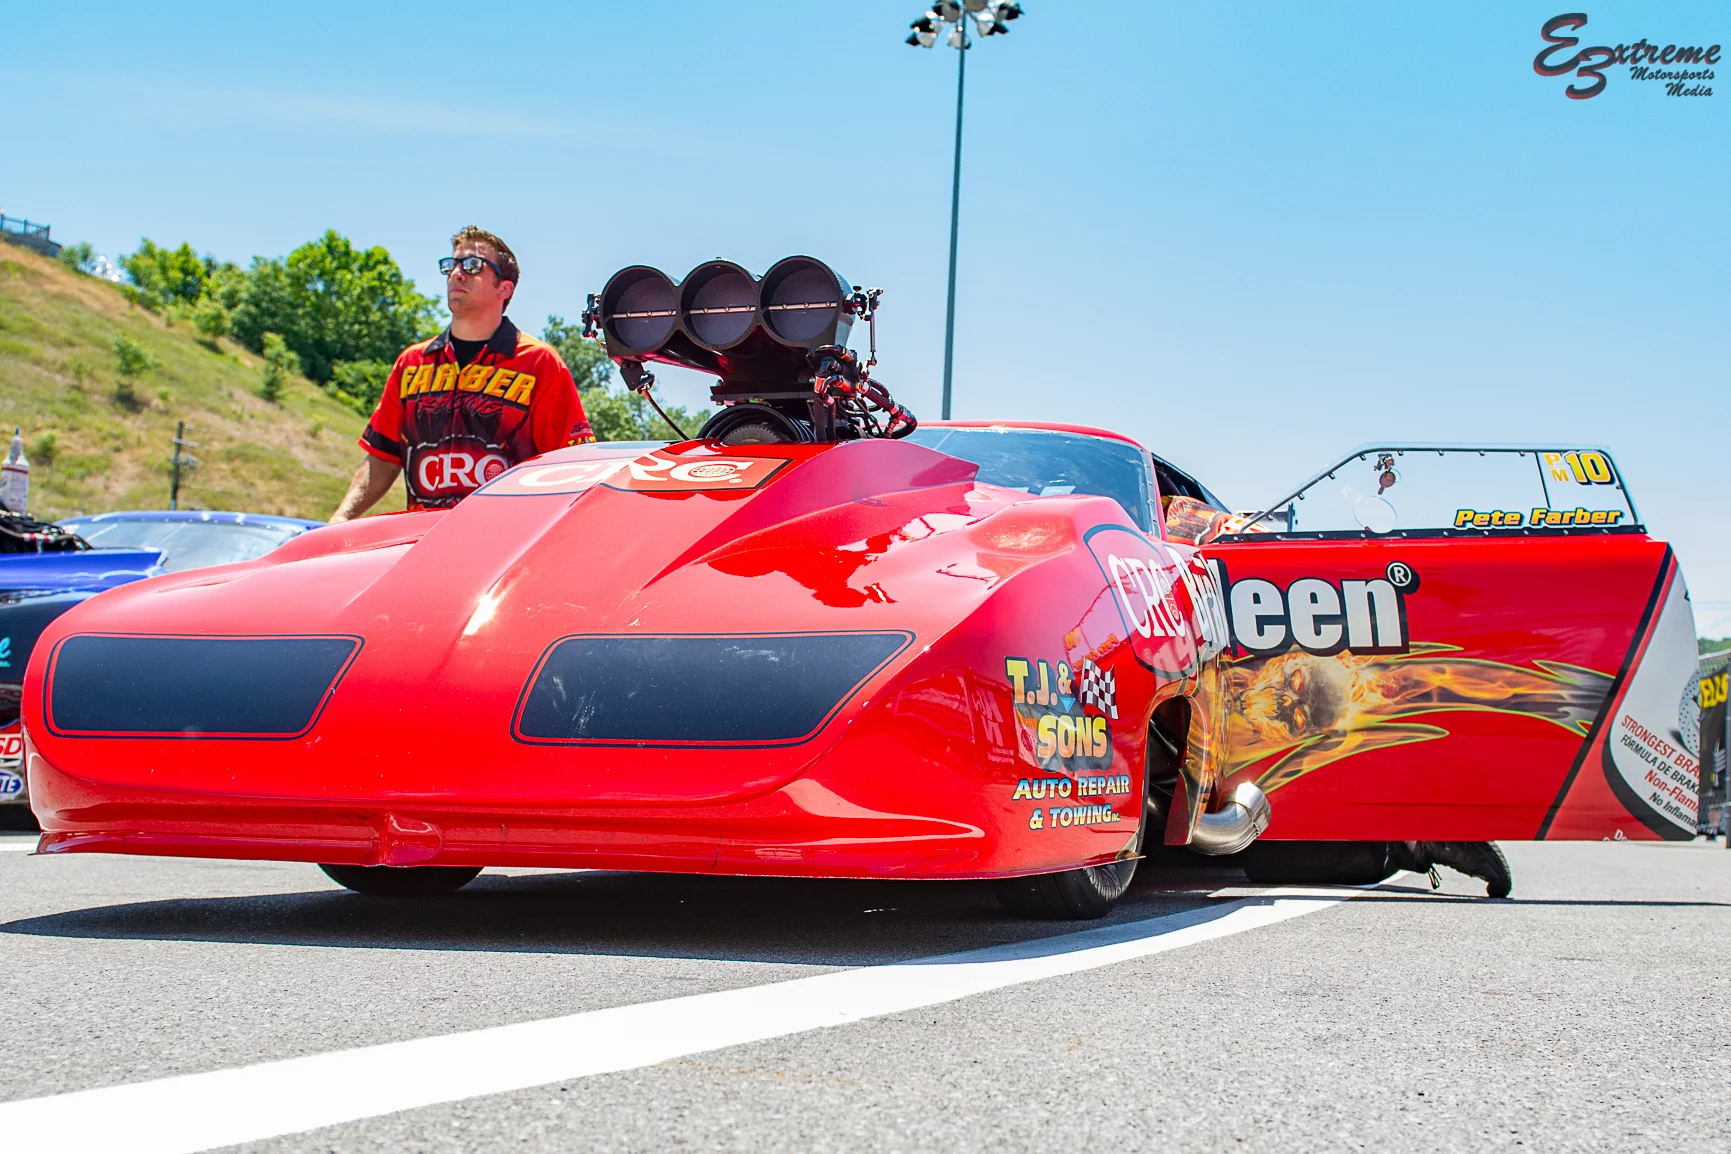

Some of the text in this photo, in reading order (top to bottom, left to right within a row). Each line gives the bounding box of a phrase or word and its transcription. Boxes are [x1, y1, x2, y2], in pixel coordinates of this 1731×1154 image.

[400, 361, 536, 406] FARBER
[1564, 451, 1614, 485] 10
[1454, 508, 1624, 528] Pete Farber
[1005, 658, 1072, 706] T.J. &
[1038, 714, 1108, 759] SONS
[1621, 715, 1699, 779] STRONGEST BRA
[1657, 761, 1672, 776] DE
[1012, 775, 1130, 800] AUTO REPAIR
[1649, 792, 1663, 806] No
[1029, 808, 1044, 830] &
[1049, 803, 1112, 828] TOWING
